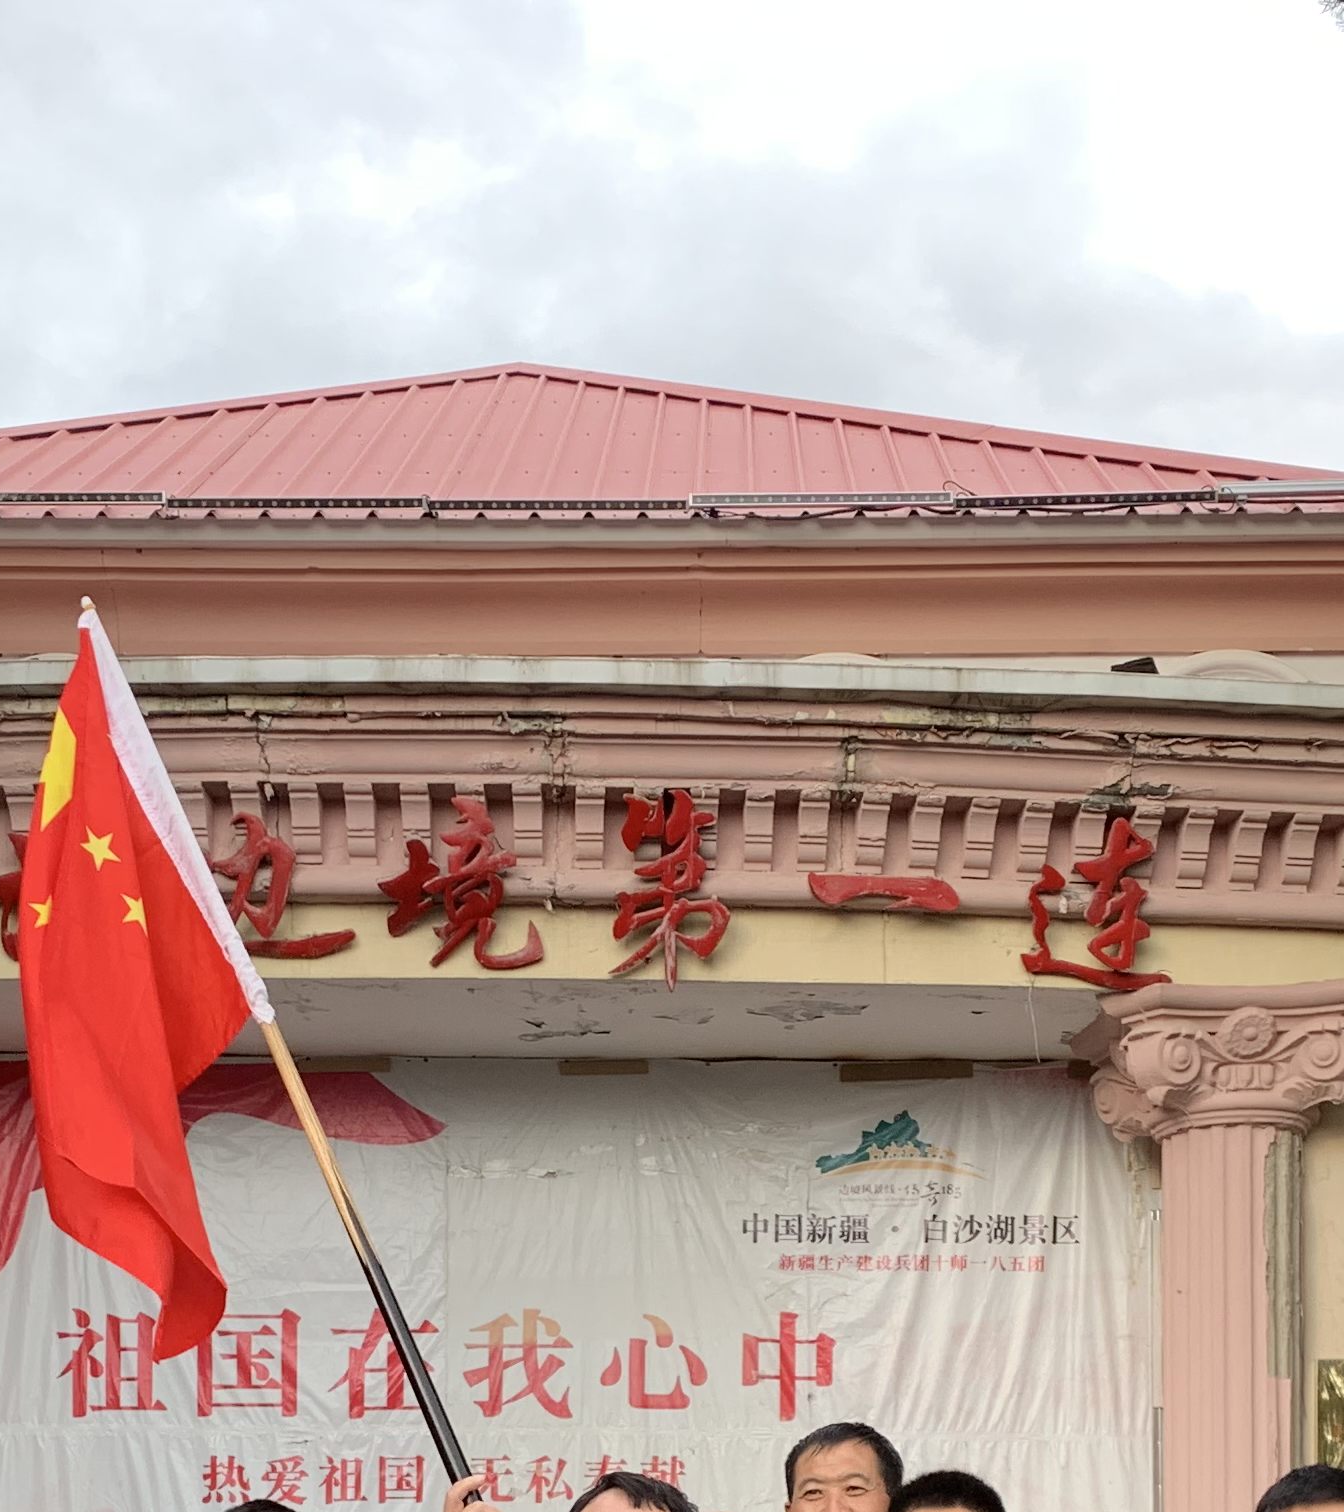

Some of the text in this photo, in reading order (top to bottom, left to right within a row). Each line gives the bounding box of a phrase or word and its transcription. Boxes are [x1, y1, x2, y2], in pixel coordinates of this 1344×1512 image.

[777, 1253, 1046, 1273] 新疆生产建设兵团十师一八五团
[56, 1307, 838, 1421] 祖国在我心中
